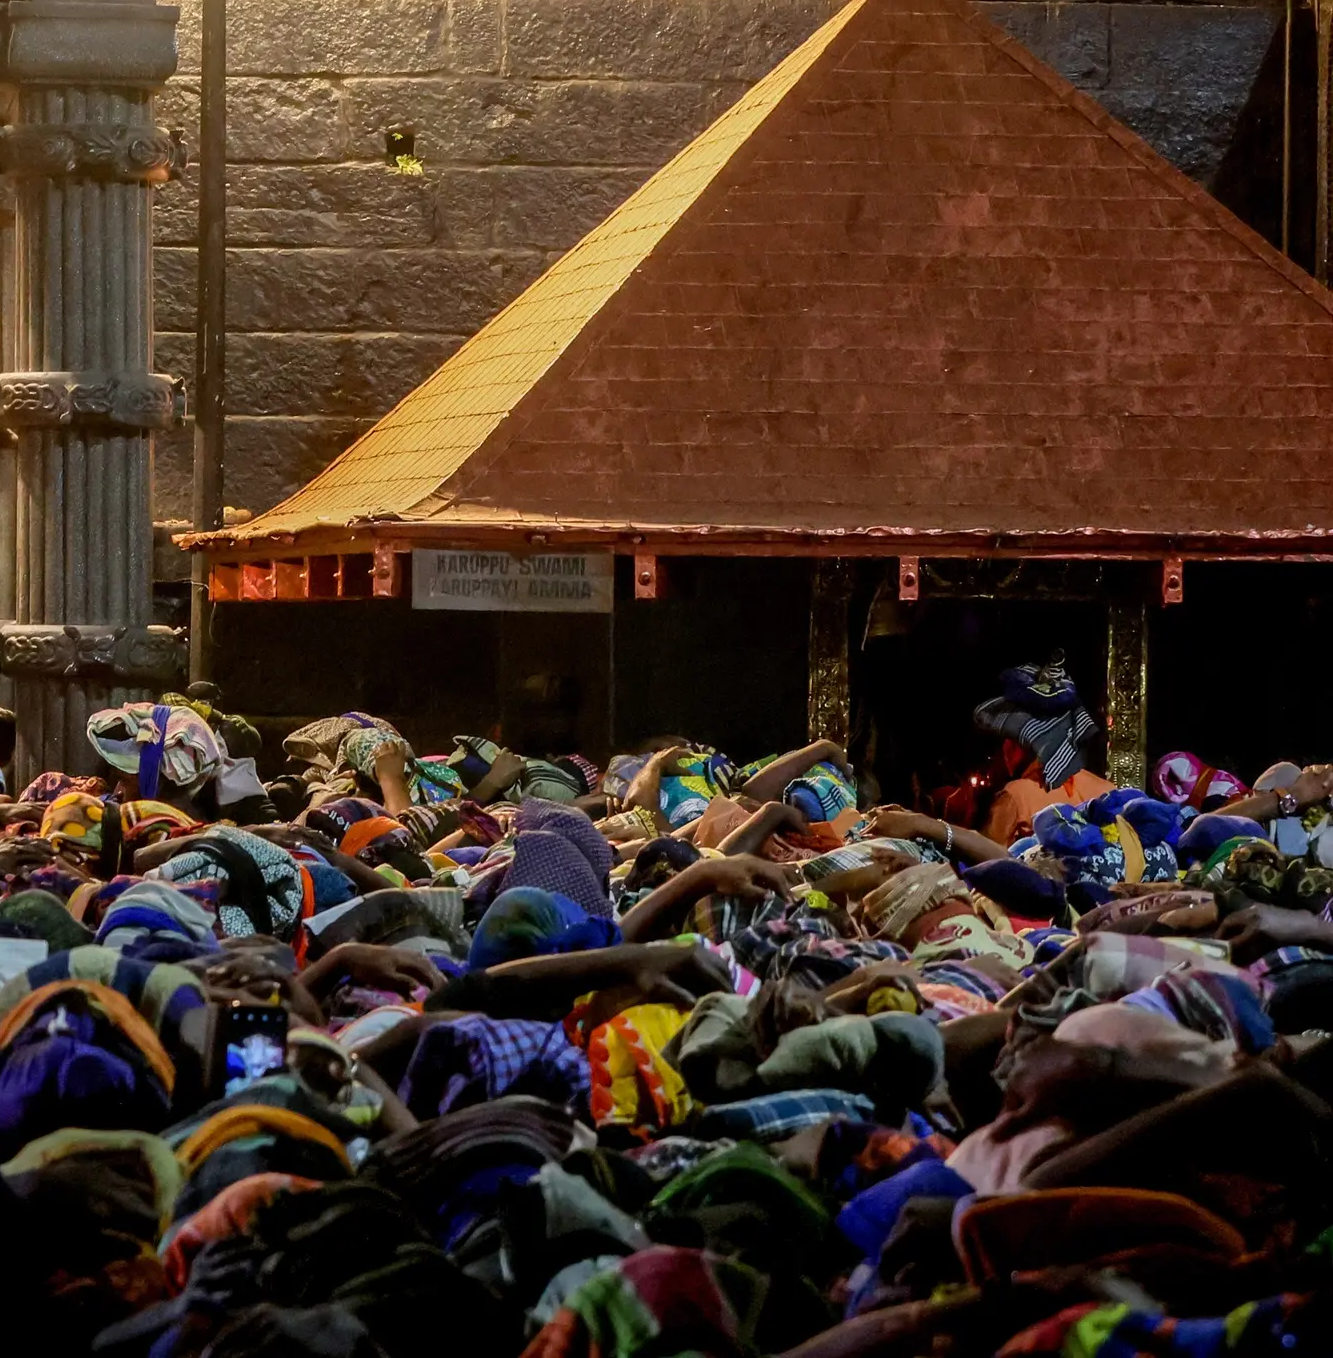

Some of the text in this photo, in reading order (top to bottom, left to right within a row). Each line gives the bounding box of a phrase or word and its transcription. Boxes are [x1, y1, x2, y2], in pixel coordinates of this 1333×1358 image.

[436, 554, 587, 576] KARUPPU SWAMI
[429, 577, 518, 599] ARUPPAYI
